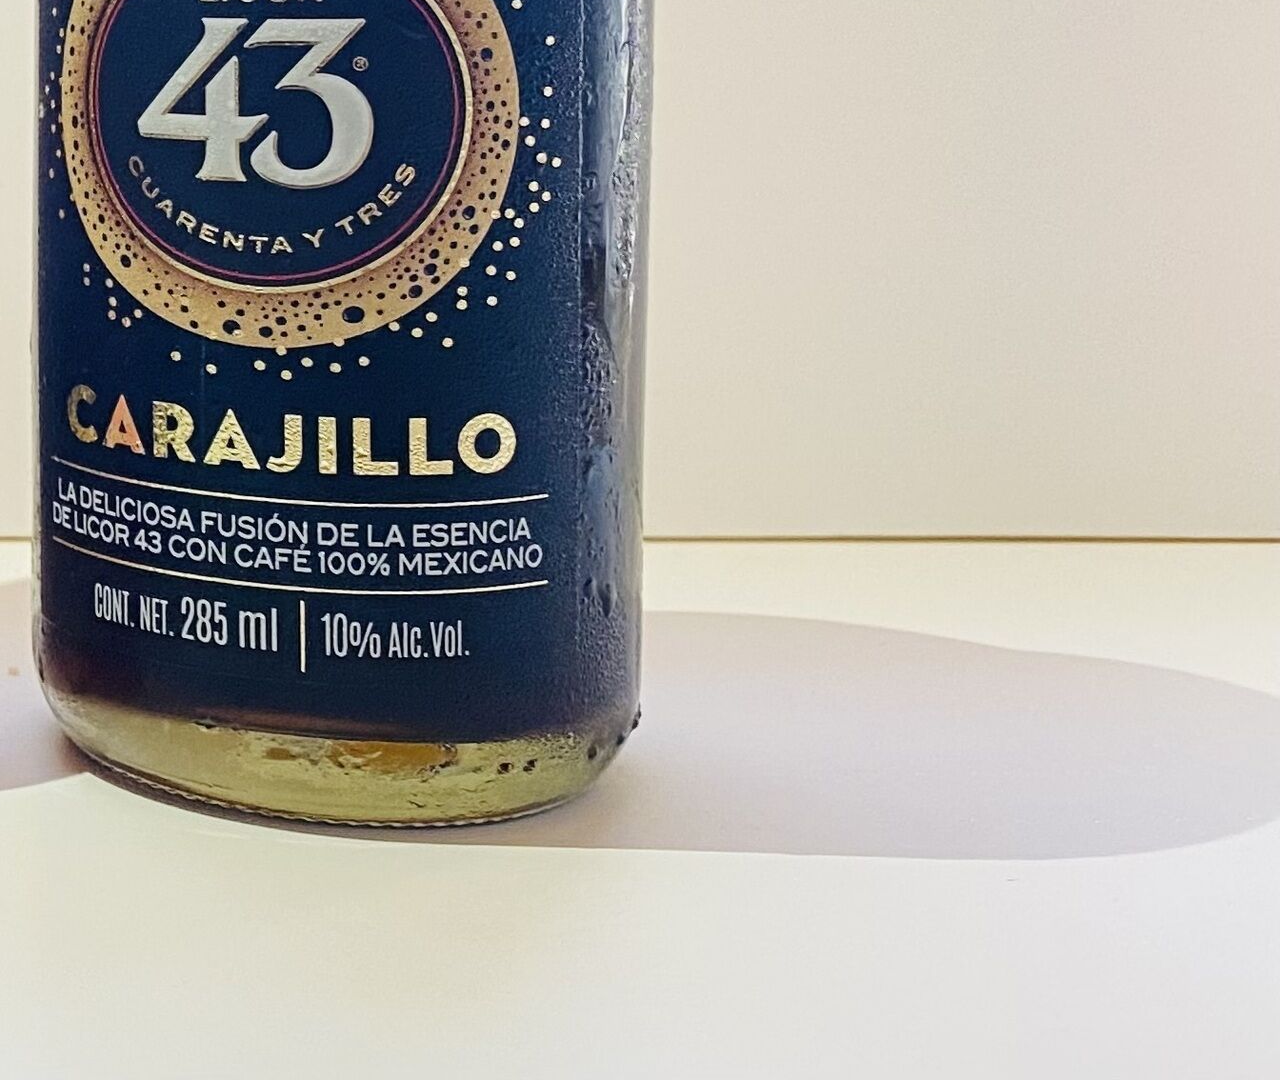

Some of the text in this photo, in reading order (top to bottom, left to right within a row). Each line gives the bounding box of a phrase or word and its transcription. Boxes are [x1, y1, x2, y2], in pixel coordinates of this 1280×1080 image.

[127, 154, 417, 255] CUARENTA Y TRES
[67, 383, 517, 477] CARAJILLO
[52, 500, 544, 577] DE LICOR 43 CON CAFÉ 100% MEXICANO
[58, 477, 532, 548] LA DELICIOSA FUSIÓN DE LA ESENCIA
[94, 582, 136, 629] CONT.
[140, 594, 174, 638] NET.
[180, 596, 228, 646] 285
[238, 606, 278, 652] ml
[321, 613, 382, 659] 10%
